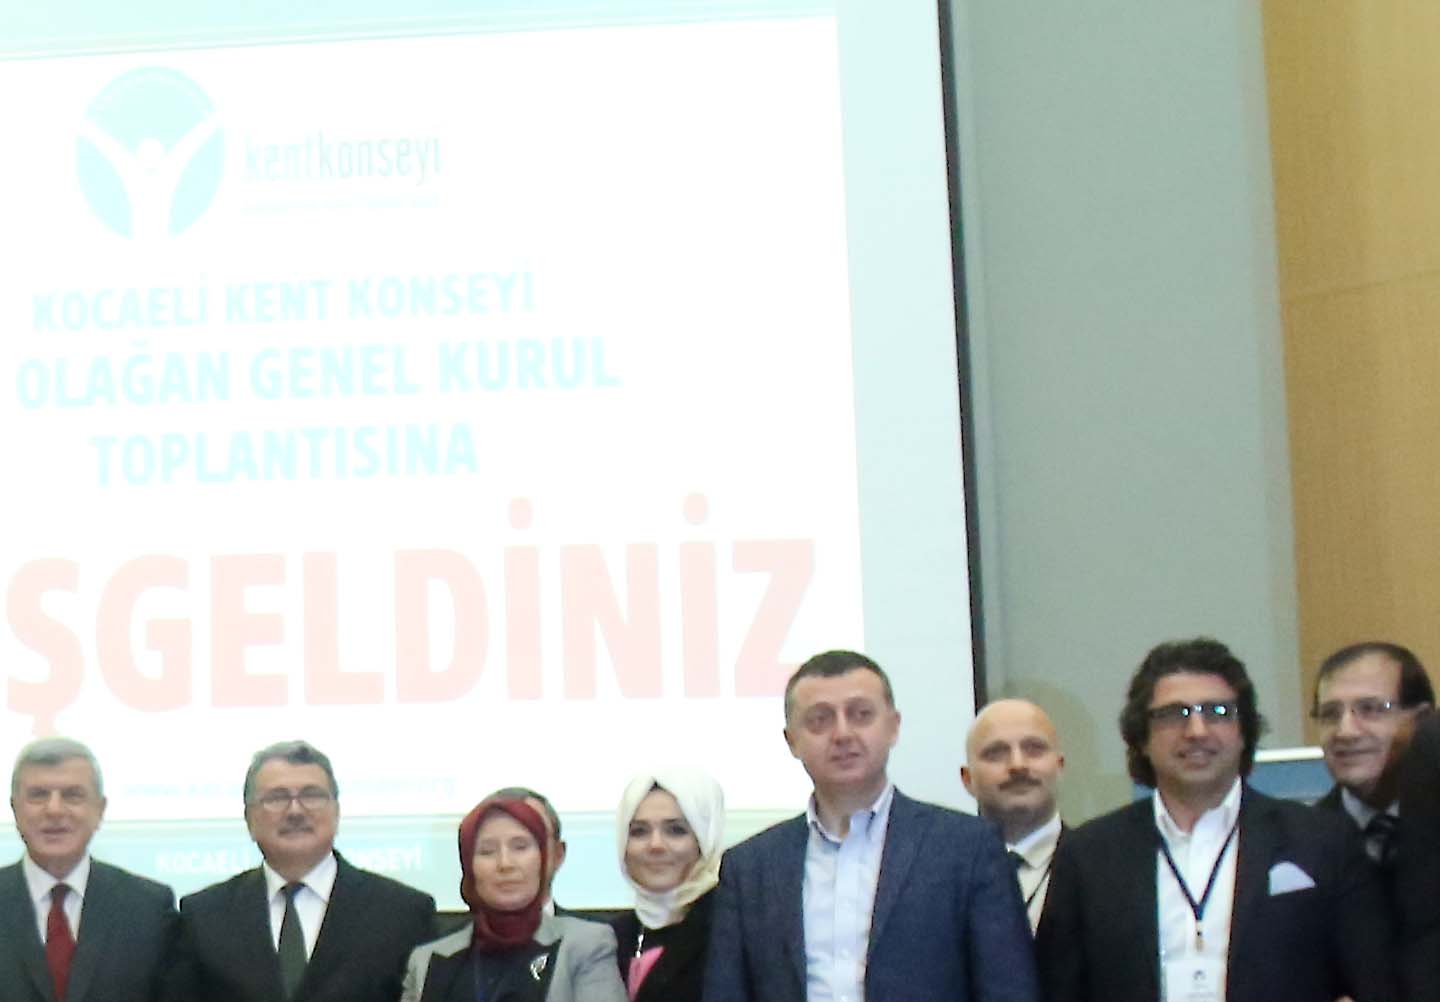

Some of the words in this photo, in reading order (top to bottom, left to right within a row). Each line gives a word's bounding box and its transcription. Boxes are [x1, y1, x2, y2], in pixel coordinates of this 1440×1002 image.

[31, 272, 210, 333] KOCAELİ
[224, 278, 333, 326] KENT
[347, 259, 536, 320] KONSEYİ
[15, 338, 231, 411] OLAĞAN
[248, 342, 423, 401] GENEL
[437, 336, 625, 394] KURUL
[87, 420, 480, 488] TOPLANTISINA
